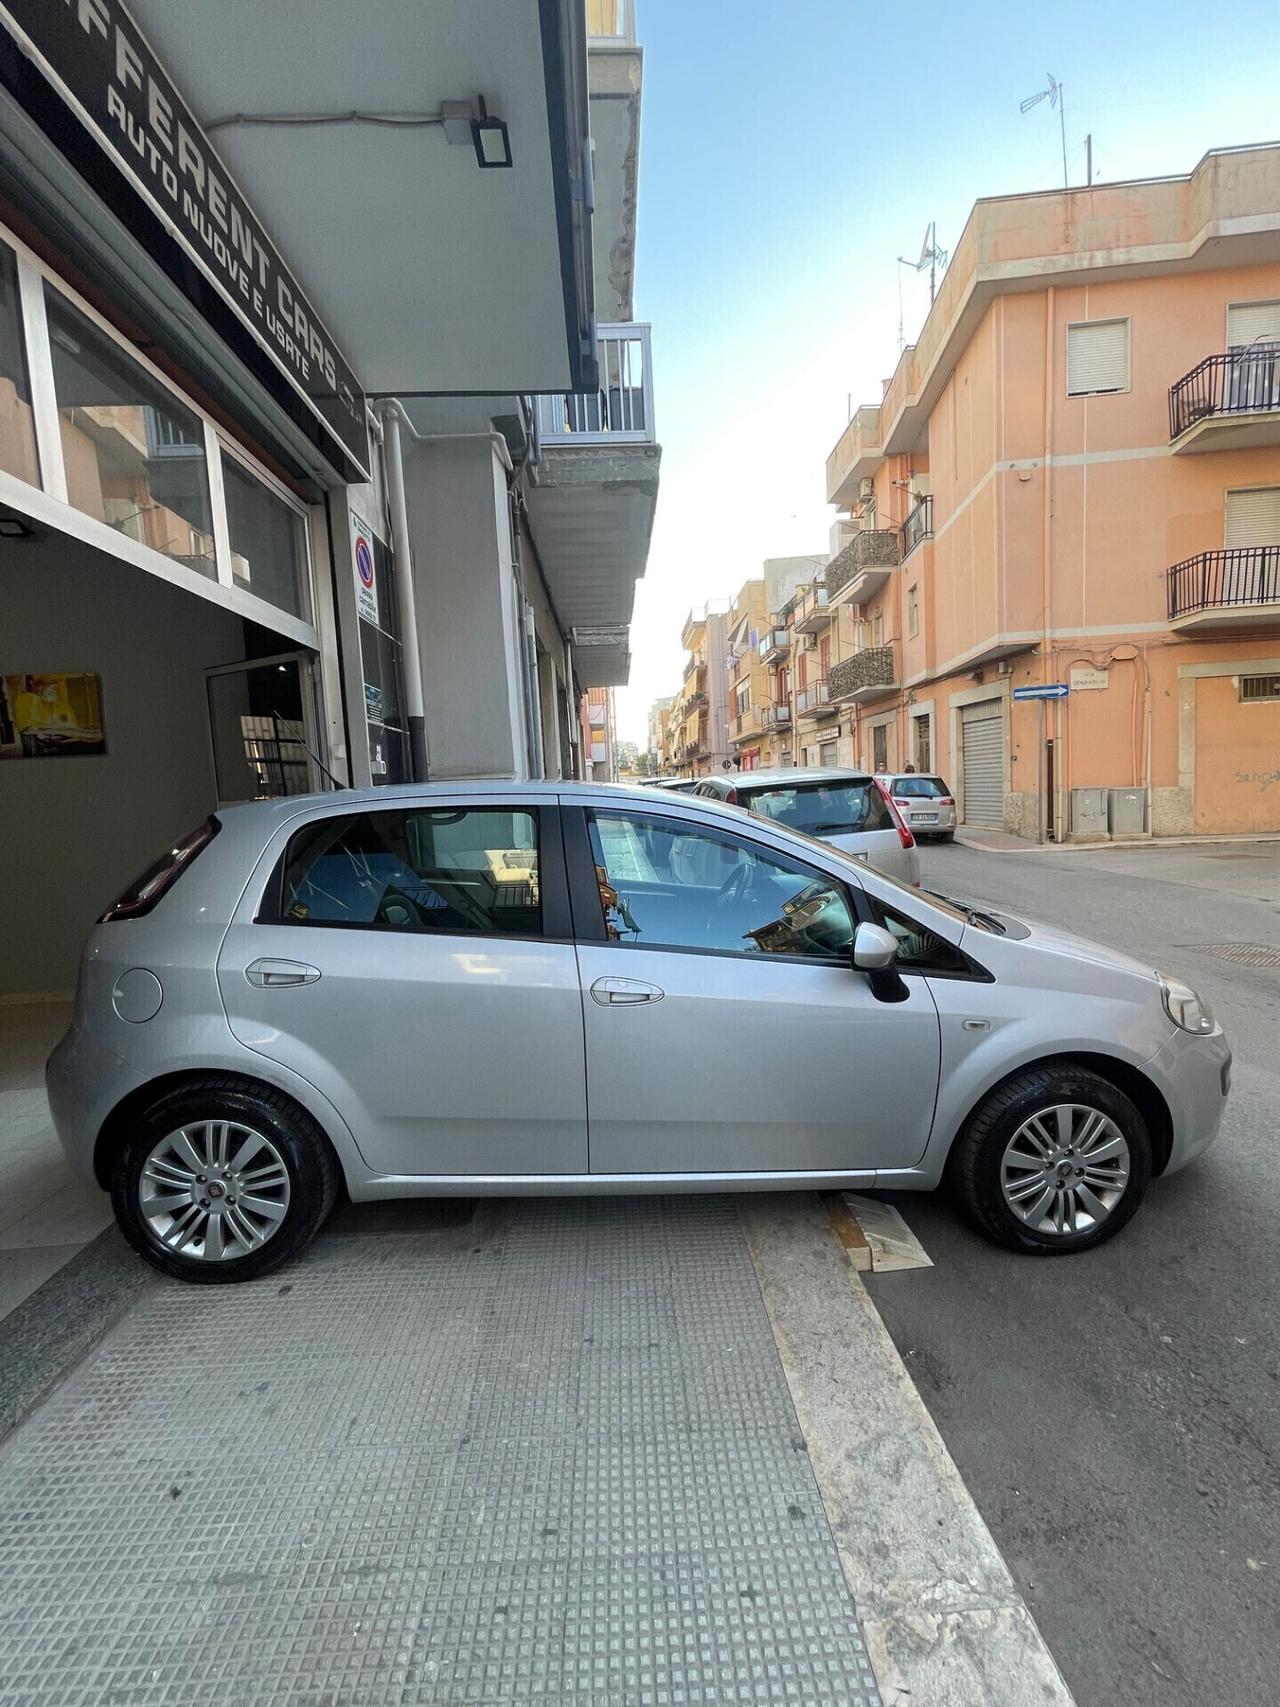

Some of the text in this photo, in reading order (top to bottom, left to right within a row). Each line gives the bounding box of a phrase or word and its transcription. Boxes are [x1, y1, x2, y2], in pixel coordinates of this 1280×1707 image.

[70, 0, 337, 392] FFERENT CARS
[107, 84, 310, 382] AUTO NUOVE E USATE
